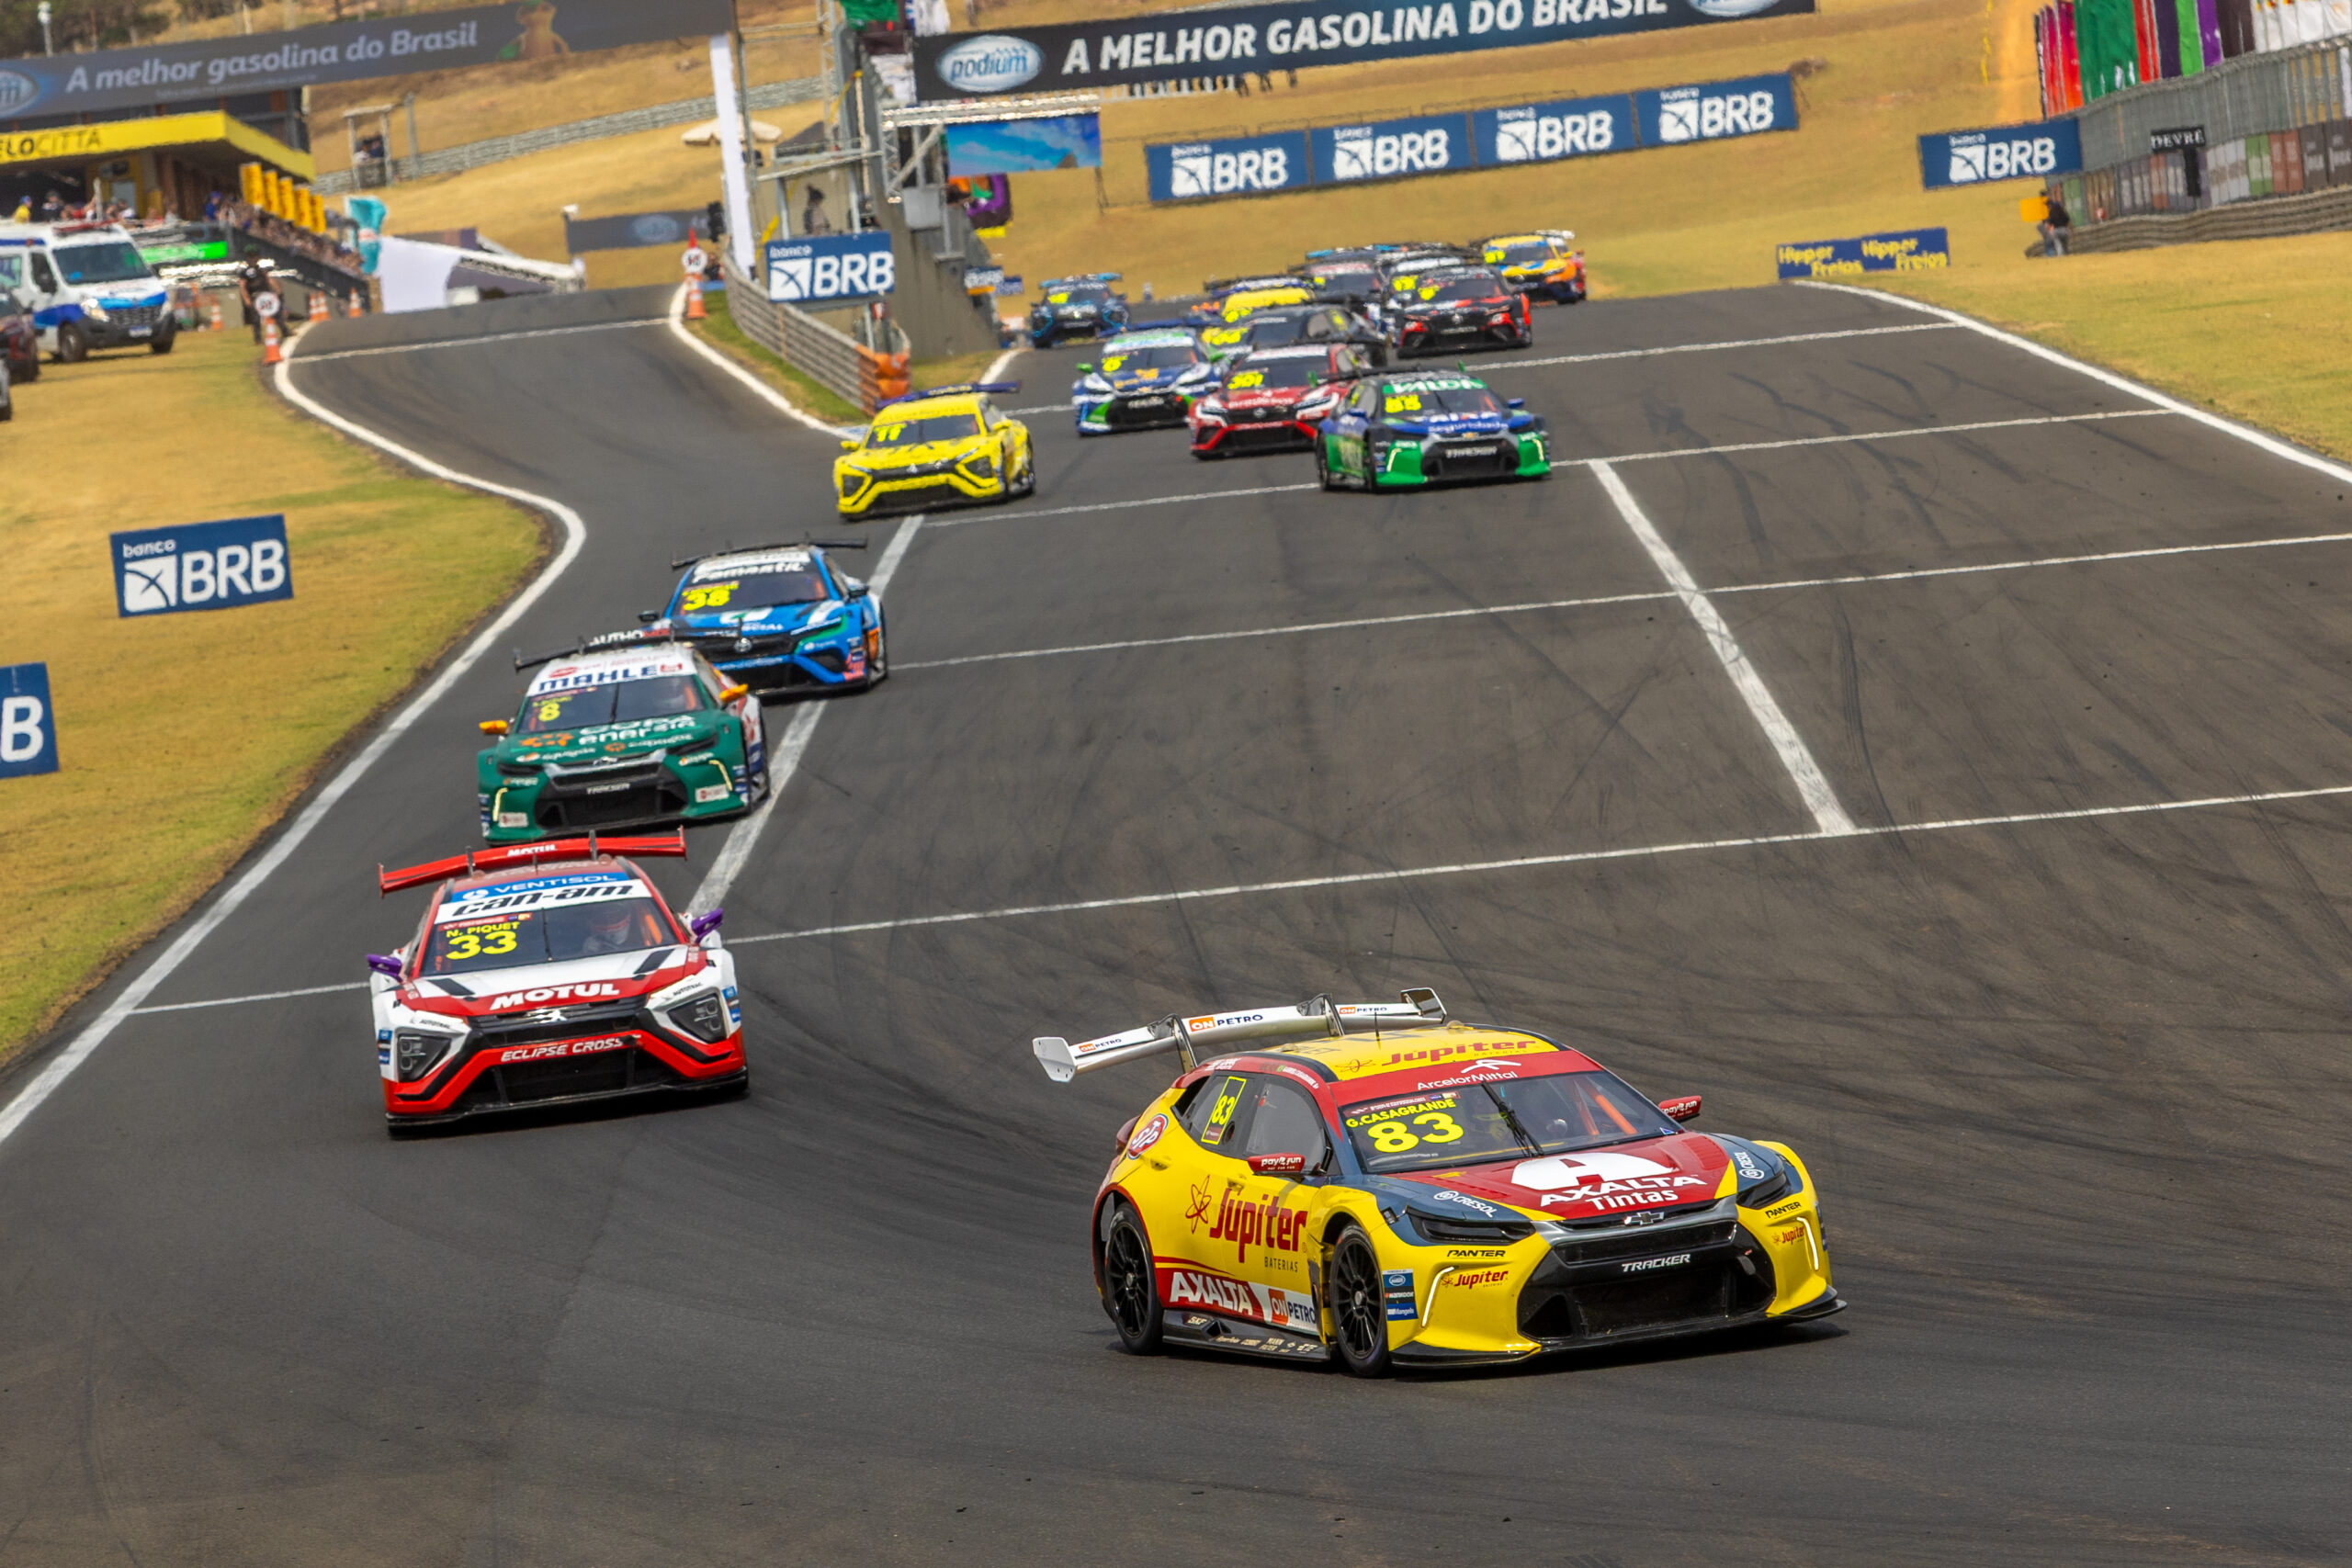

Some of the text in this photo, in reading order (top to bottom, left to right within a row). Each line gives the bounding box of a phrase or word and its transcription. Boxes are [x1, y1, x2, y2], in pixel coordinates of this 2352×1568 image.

[1061, 39, 1091, 74] A
[1099, 23, 1257, 71] MELHOR
[1266, 3, 1459, 55] GASOLINA
[1468, 0, 1523, 34] DO
[65, 65, 89, 93] A
[95, 58, 202, 90] melhor
[208, 44, 338, 85] gasolina
[345, 34, 384, 61] do
[390, 20, 478, 56] Brasil
[950, 52, 1028, 81] podium
[1701, 91, 1773, 137] BRB
[1537, 110, 1612, 157] BRB
[1374, 129, 1449, 174] BRB
[1986, 137, 2056, 178] BRB
[1213, 147, 1289, 193] BRB
[814, 252, 895, 297] BRB
[123, 539, 176, 558] banco
[181, 539, 285, 604] BRB
[538, 703, 560, 721] 8
[495, 875, 617, 893] VENTISOL
[452, 886, 633, 917] can-am
[446, 927, 462, 937] N.
[468, 921, 520, 934] PIQUET
[446, 931, 517, 960] 33
[490, 983, 620, 1010] MOTUL
[1192, 1014, 1263, 1031] ON PETRO
[501, 1037, 624, 1062] ECLIPSE CROSS
[1095, 1039, 1122, 1048] PETRO
[1417, 1071, 1518, 1090] ArcelorMittal
[1212, 1095, 1235, 1125] 83
[1346, 1099, 1456, 1128] G.CASAGRANDE
[1368, 1112, 1464, 1153] 83
[1540, 1176, 1707, 1208] AXALTA
[1584, 1190, 1679, 1211] Tintas
[1453, 1196, 1498, 1218] CRESOL
[1765, 1201, 1801, 1218] PANTER
[1264, 1256, 1298, 1273] BATERIAS
[1447, 1249, 1506, 1258] PANTER
[1622, 1254, 1690, 1272] TRACKER
[1170, 1271, 1253, 1316] AXALTA
[1272, 1297, 1316, 1324] ON PETRO
